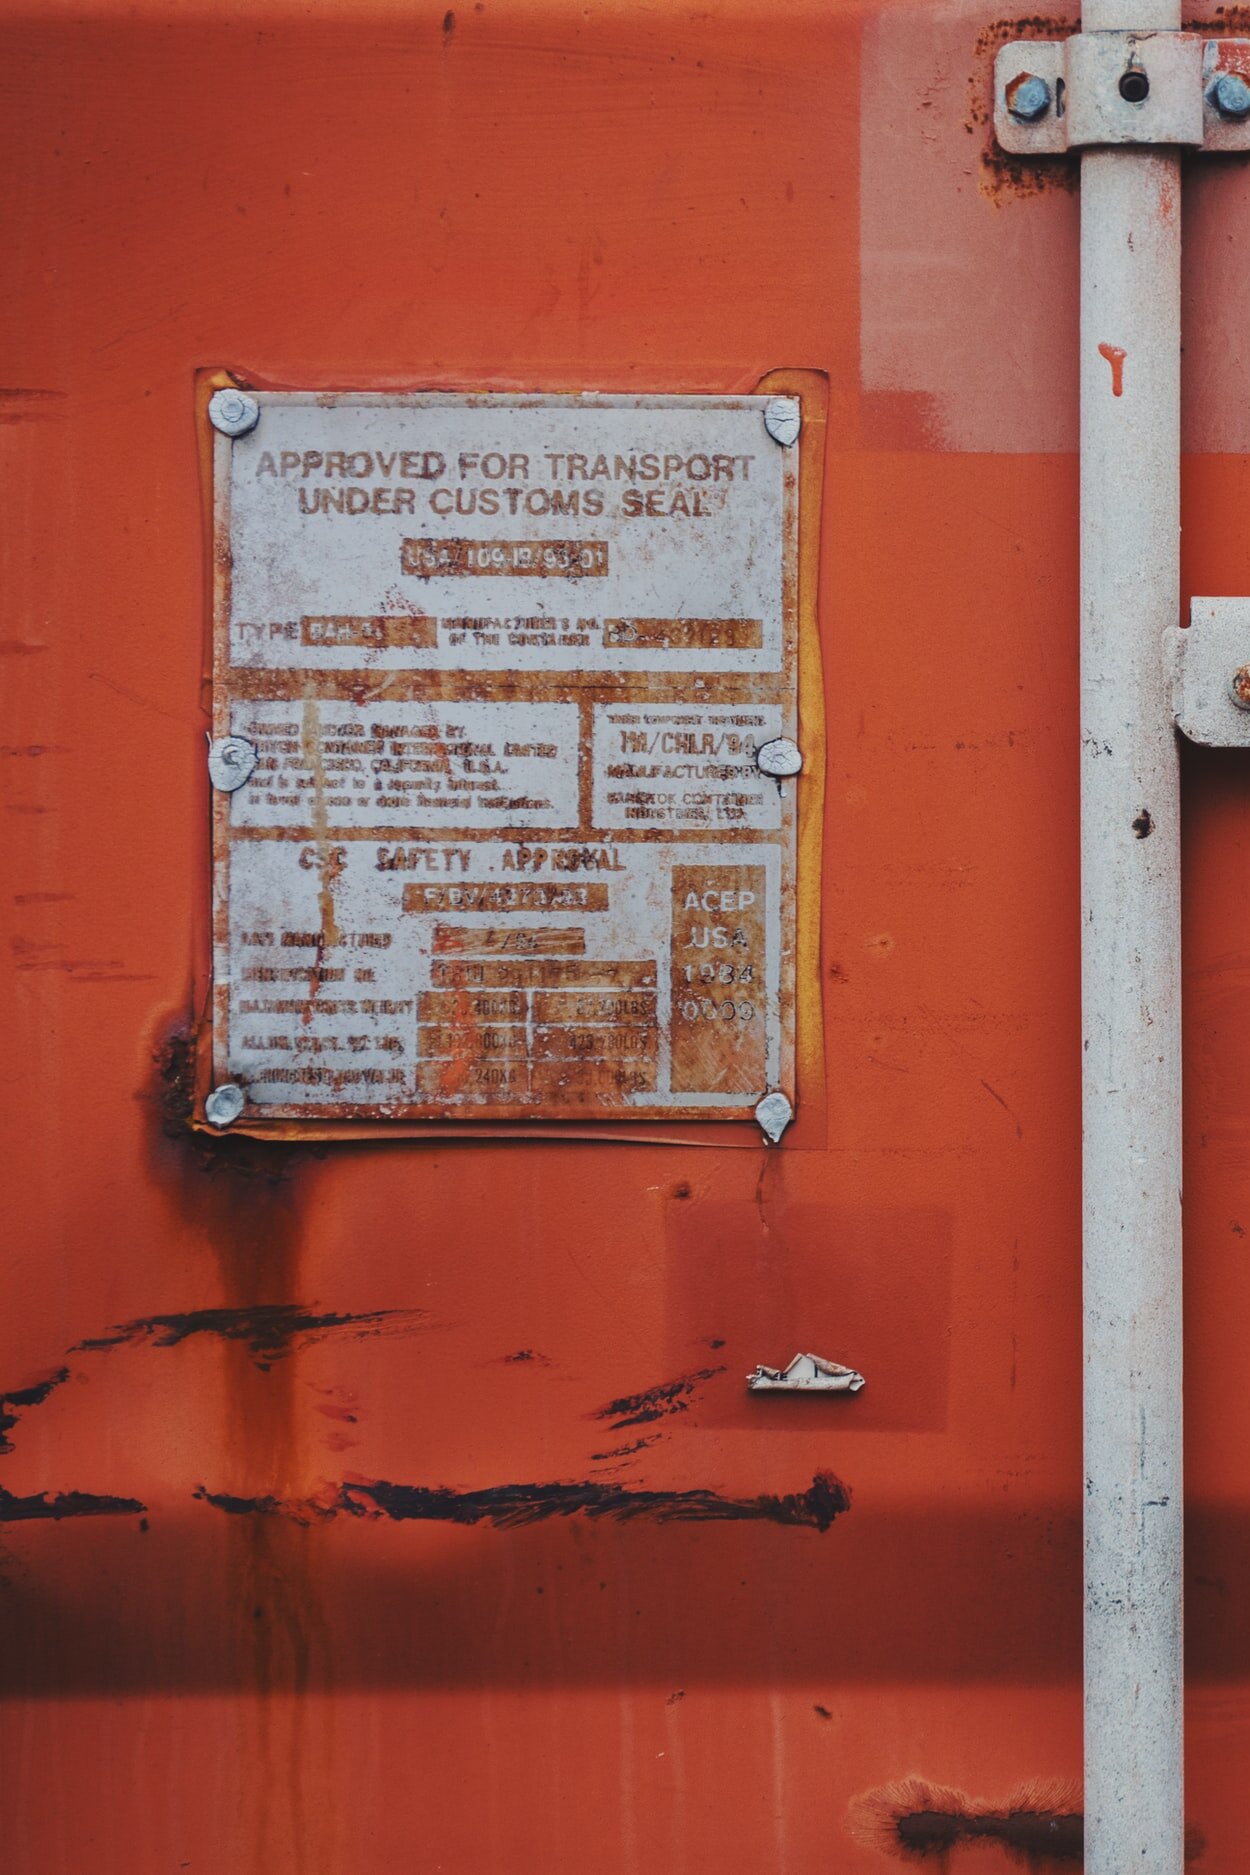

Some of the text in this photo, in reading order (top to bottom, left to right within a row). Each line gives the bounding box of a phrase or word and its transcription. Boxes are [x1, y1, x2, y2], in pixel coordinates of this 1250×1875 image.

[256, 451, 755, 481] APPROVED FOR TRANSPORT
[299, 487, 712, 516] UNDER CUSTOMS SEAL
[235, 622, 298, 640] TYPE
[375, 846, 471, 871] SAFETY
[502, 847, 626, 871] APPROVAL
[684, 890, 755, 912] ACEP
[690, 926, 747, 949] USA
